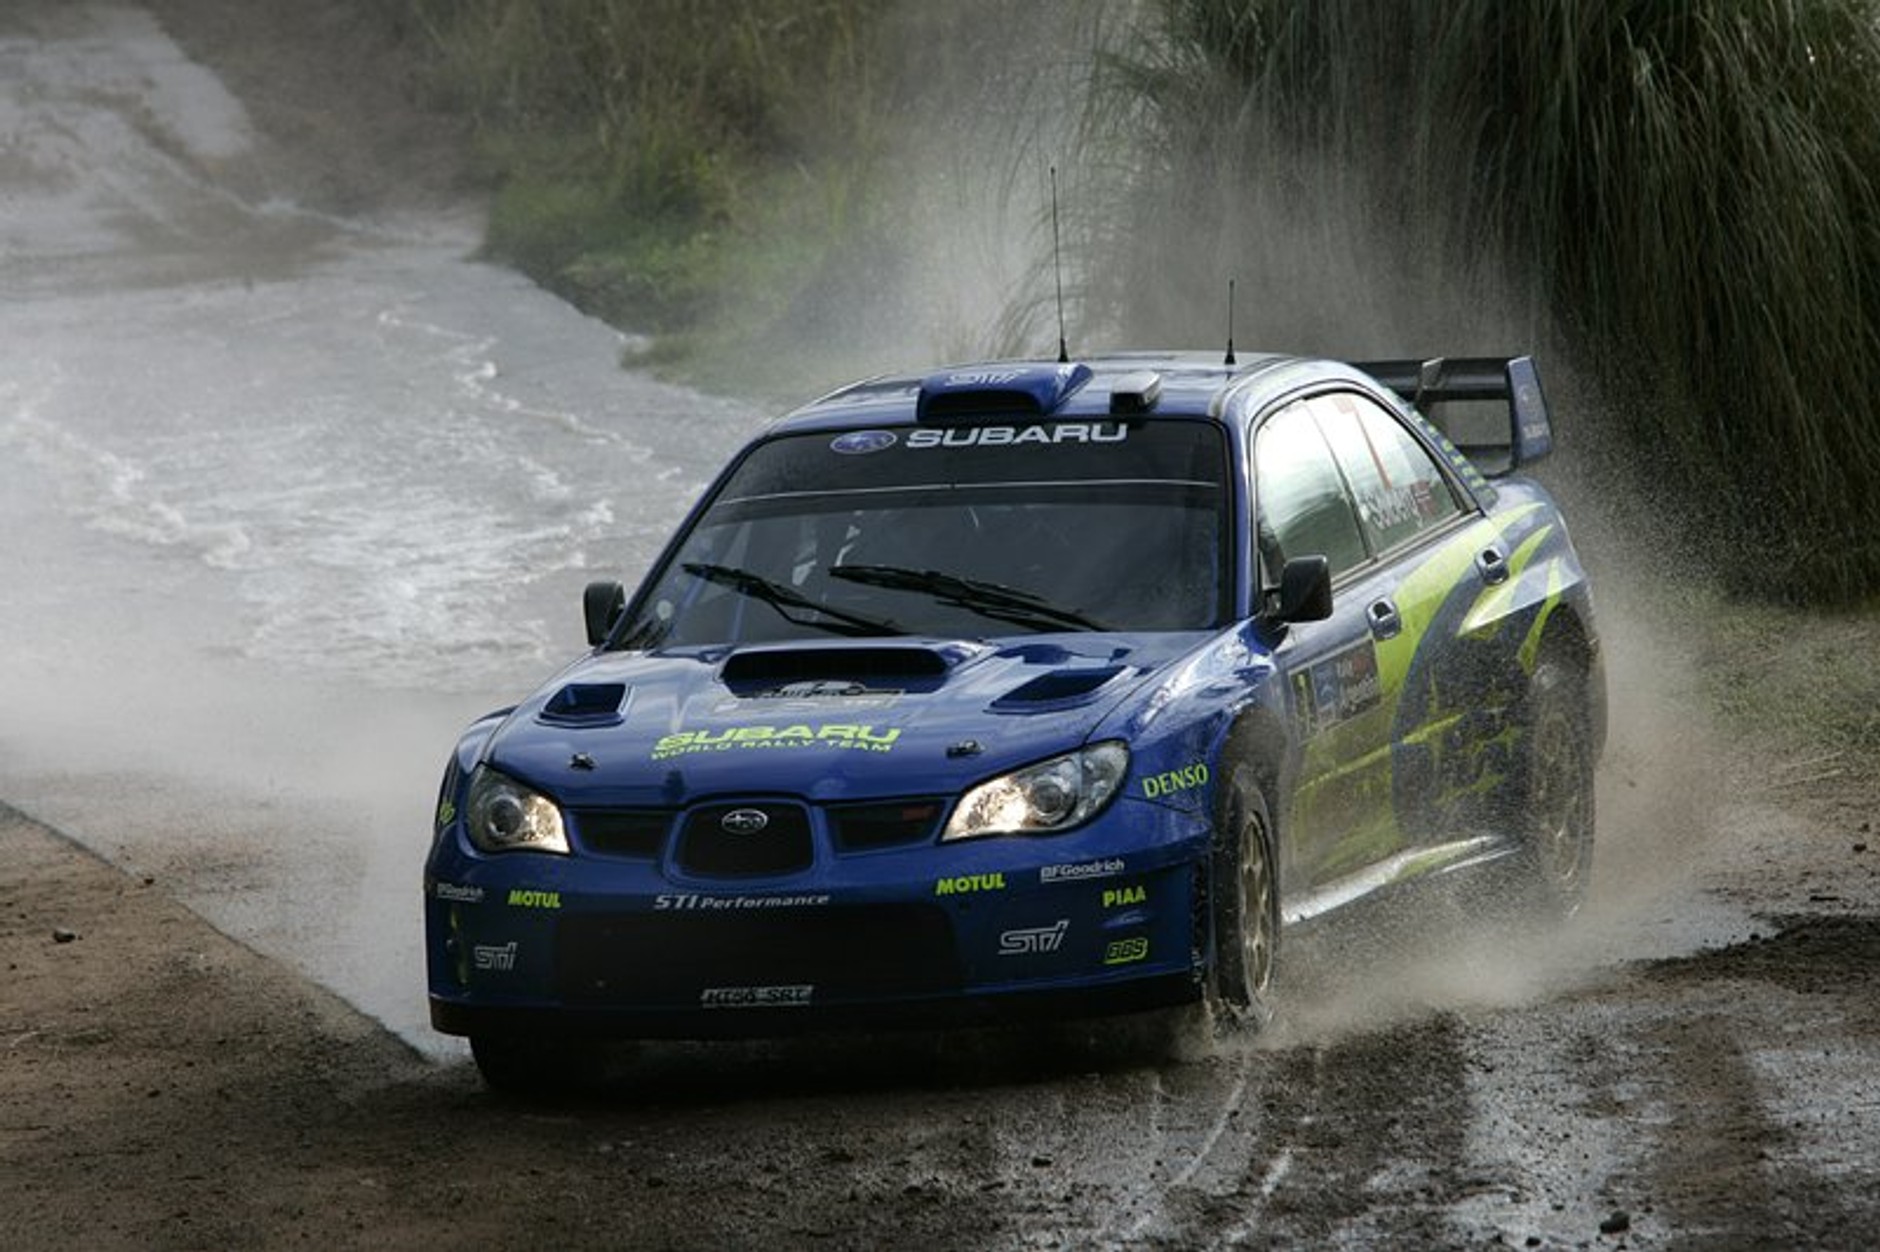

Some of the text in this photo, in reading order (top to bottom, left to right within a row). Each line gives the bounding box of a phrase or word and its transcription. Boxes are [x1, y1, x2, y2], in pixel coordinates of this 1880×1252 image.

[905, 423, 1127, 448] SUBARU
[655, 725, 900, 750] SUBARU
[651, 738, 891, 761] WORLD RALLY TEAM
[1142, 763, 1209, 798] DENSO
[1040, 858, 1125, 881] BFGoodrich
[936, 872, 1005, 896] MOTUL
[507, 890, 561, 908] MOTUL
[654, 894, 830, 910] STI Performance
[1103, 886, 1146, 907] PIAA
